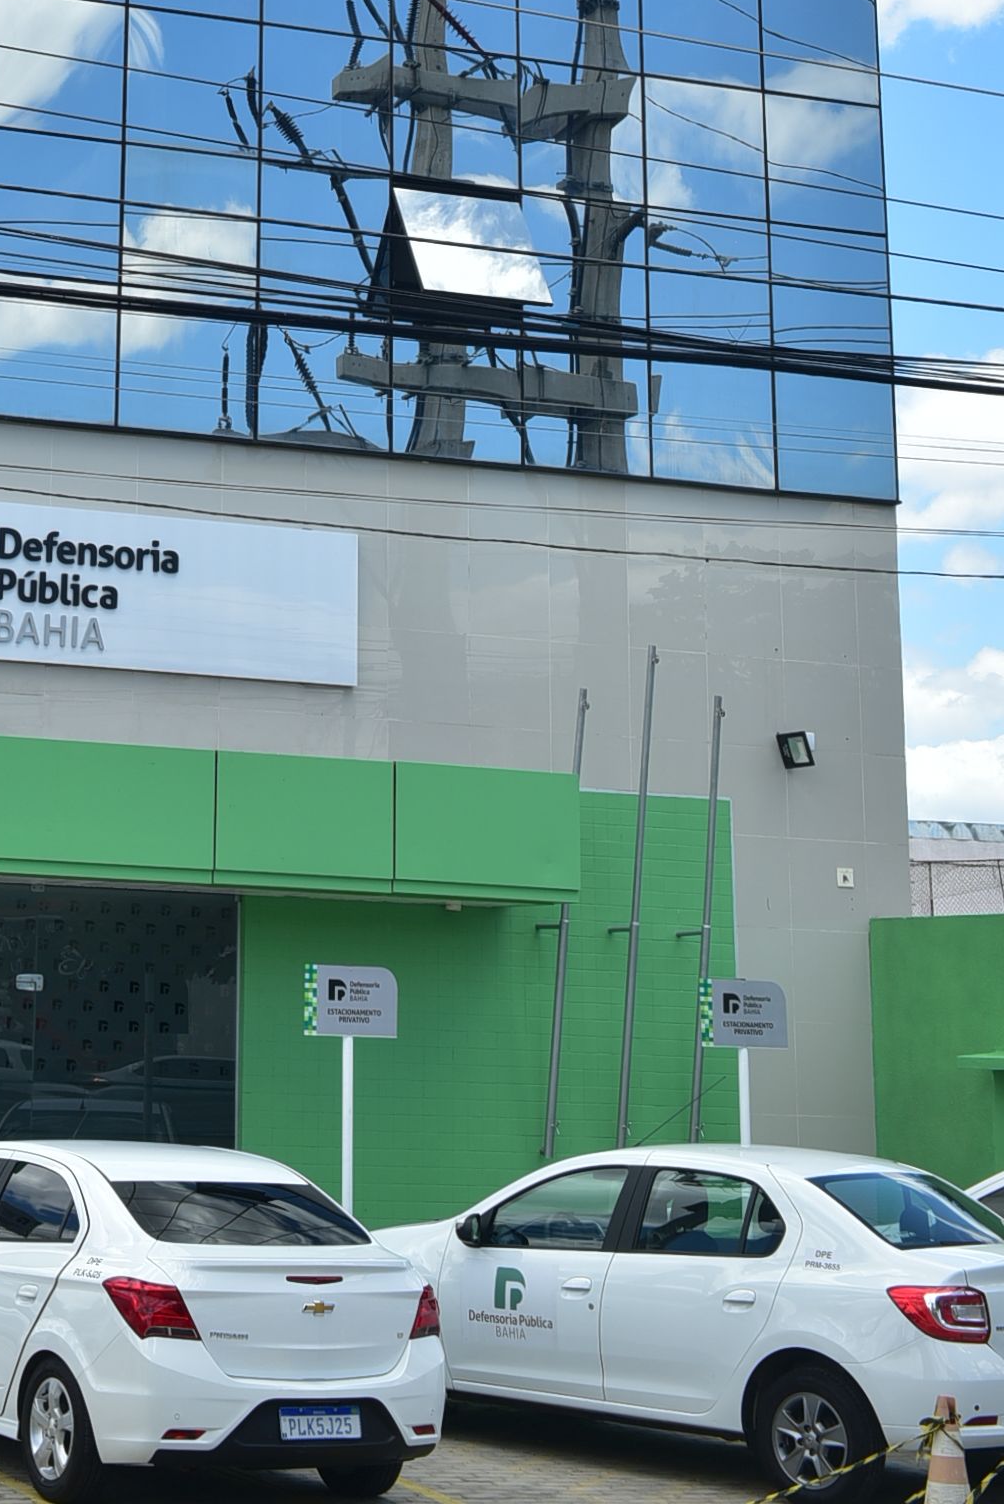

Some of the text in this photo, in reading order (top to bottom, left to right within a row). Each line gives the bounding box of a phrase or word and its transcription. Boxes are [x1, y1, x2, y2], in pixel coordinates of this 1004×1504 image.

[327, 1008, 382, 1016] ESTACIONAMENTO
[722, 1021, 774, 1029] ESTACIONAMENTO
[815, 1250, 833, 1259] DPE
[468, 1309, 554, 1330] Defensoria Pública
[495, 1325, 527, 1341] BAHIA
[288, 1415, 353, 1436] PLK5J25
